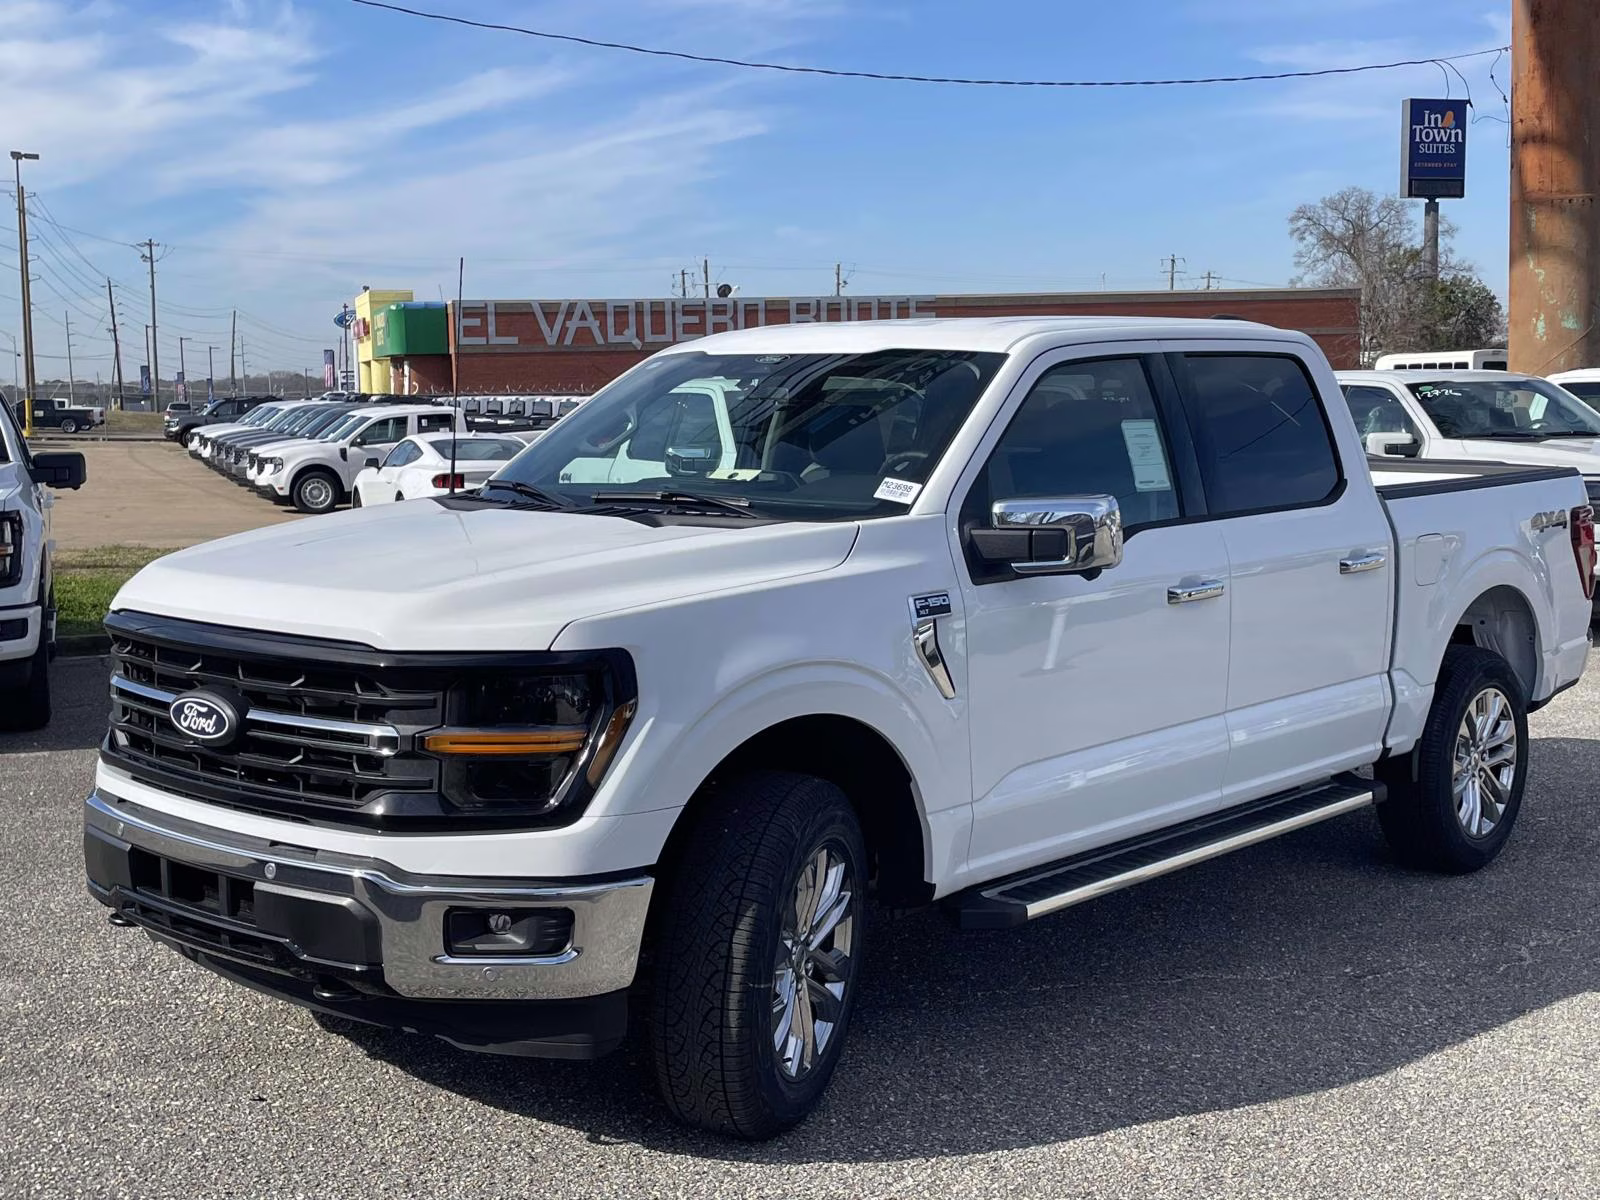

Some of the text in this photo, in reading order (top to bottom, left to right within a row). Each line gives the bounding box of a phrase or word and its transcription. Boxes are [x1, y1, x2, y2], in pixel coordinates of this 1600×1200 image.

[1424, 110, 1442, 127] In
[1412, 125, 1463, 143] Town
[1419, 143, 1456, 154] SUITES
[453, 300, 519, 345] EL
[881, 480, 914, 493] M23698
[915, 595, 950, 609] F-150
[180, 702, 217, 734] Ford
